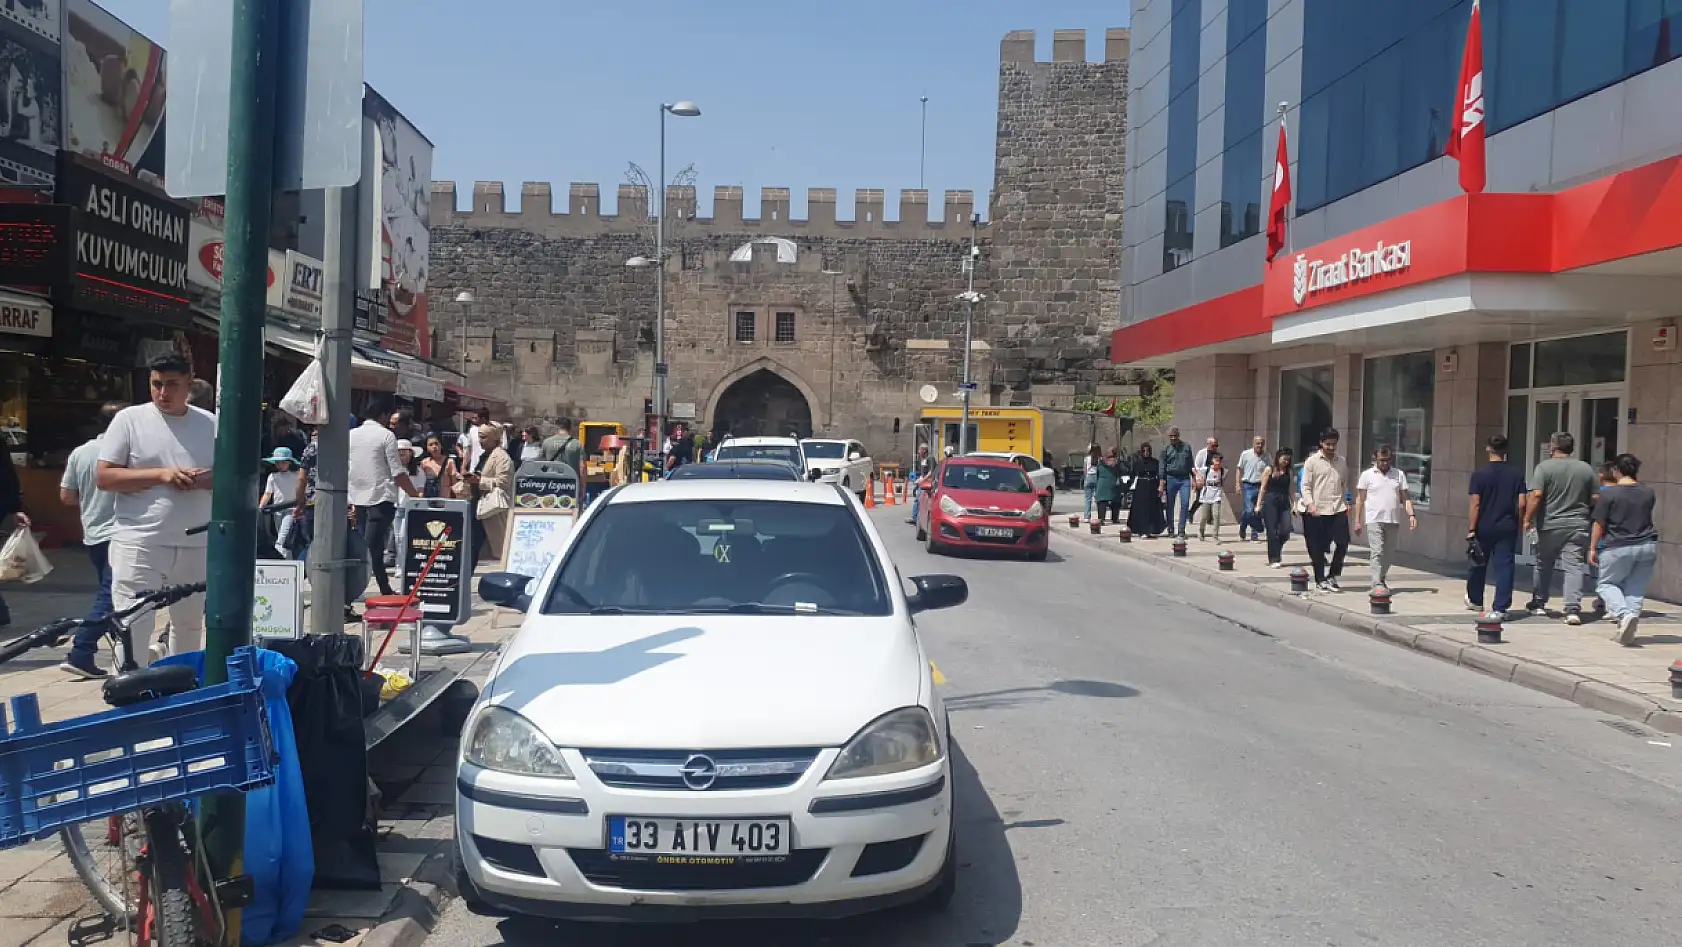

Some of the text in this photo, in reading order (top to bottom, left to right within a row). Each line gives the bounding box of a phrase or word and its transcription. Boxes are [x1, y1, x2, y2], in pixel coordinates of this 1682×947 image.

[86, 184, 185, 245] ASLI ORHAN
[76, 230, 188, 291] KUYUMCULUK
[1308, 240, 1411, 292] Ziraat Bankası
[612, 820, 781, 852] TR 33 AIV 403
